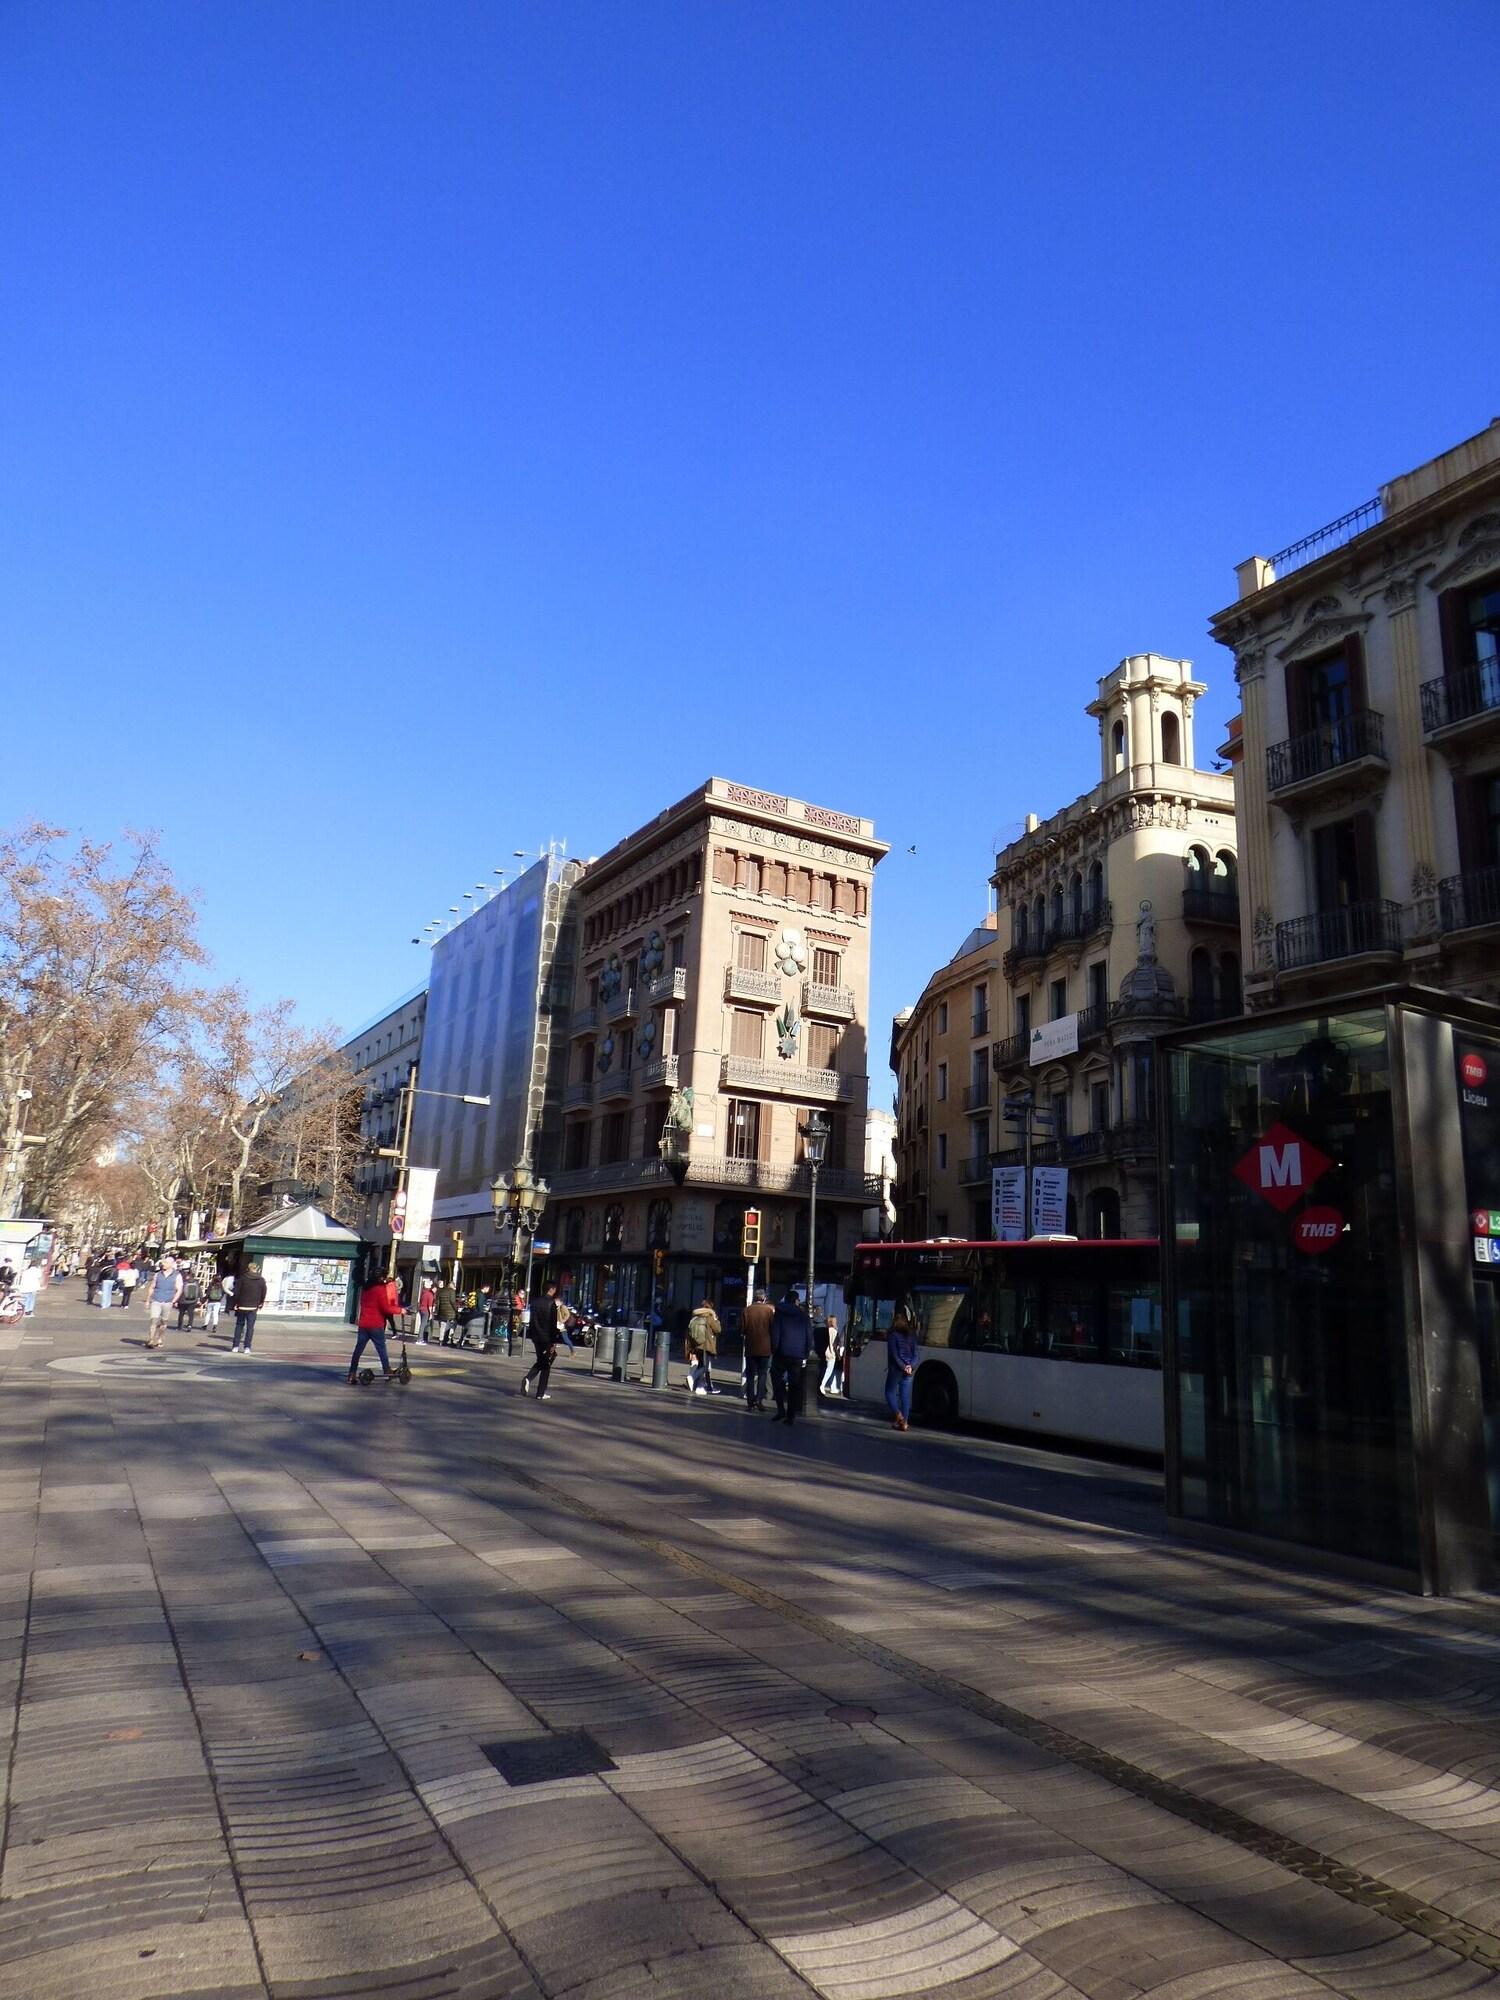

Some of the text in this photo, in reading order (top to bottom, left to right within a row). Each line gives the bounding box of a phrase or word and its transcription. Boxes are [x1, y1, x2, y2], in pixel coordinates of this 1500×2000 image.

[1465, 1064, 1483, 1078] TMB
[1462, 1088, 1489, 1107] Liceu
[1259, 1142, 1303, 1188] M
[1301, 1223, 1337, 1238] TMB
